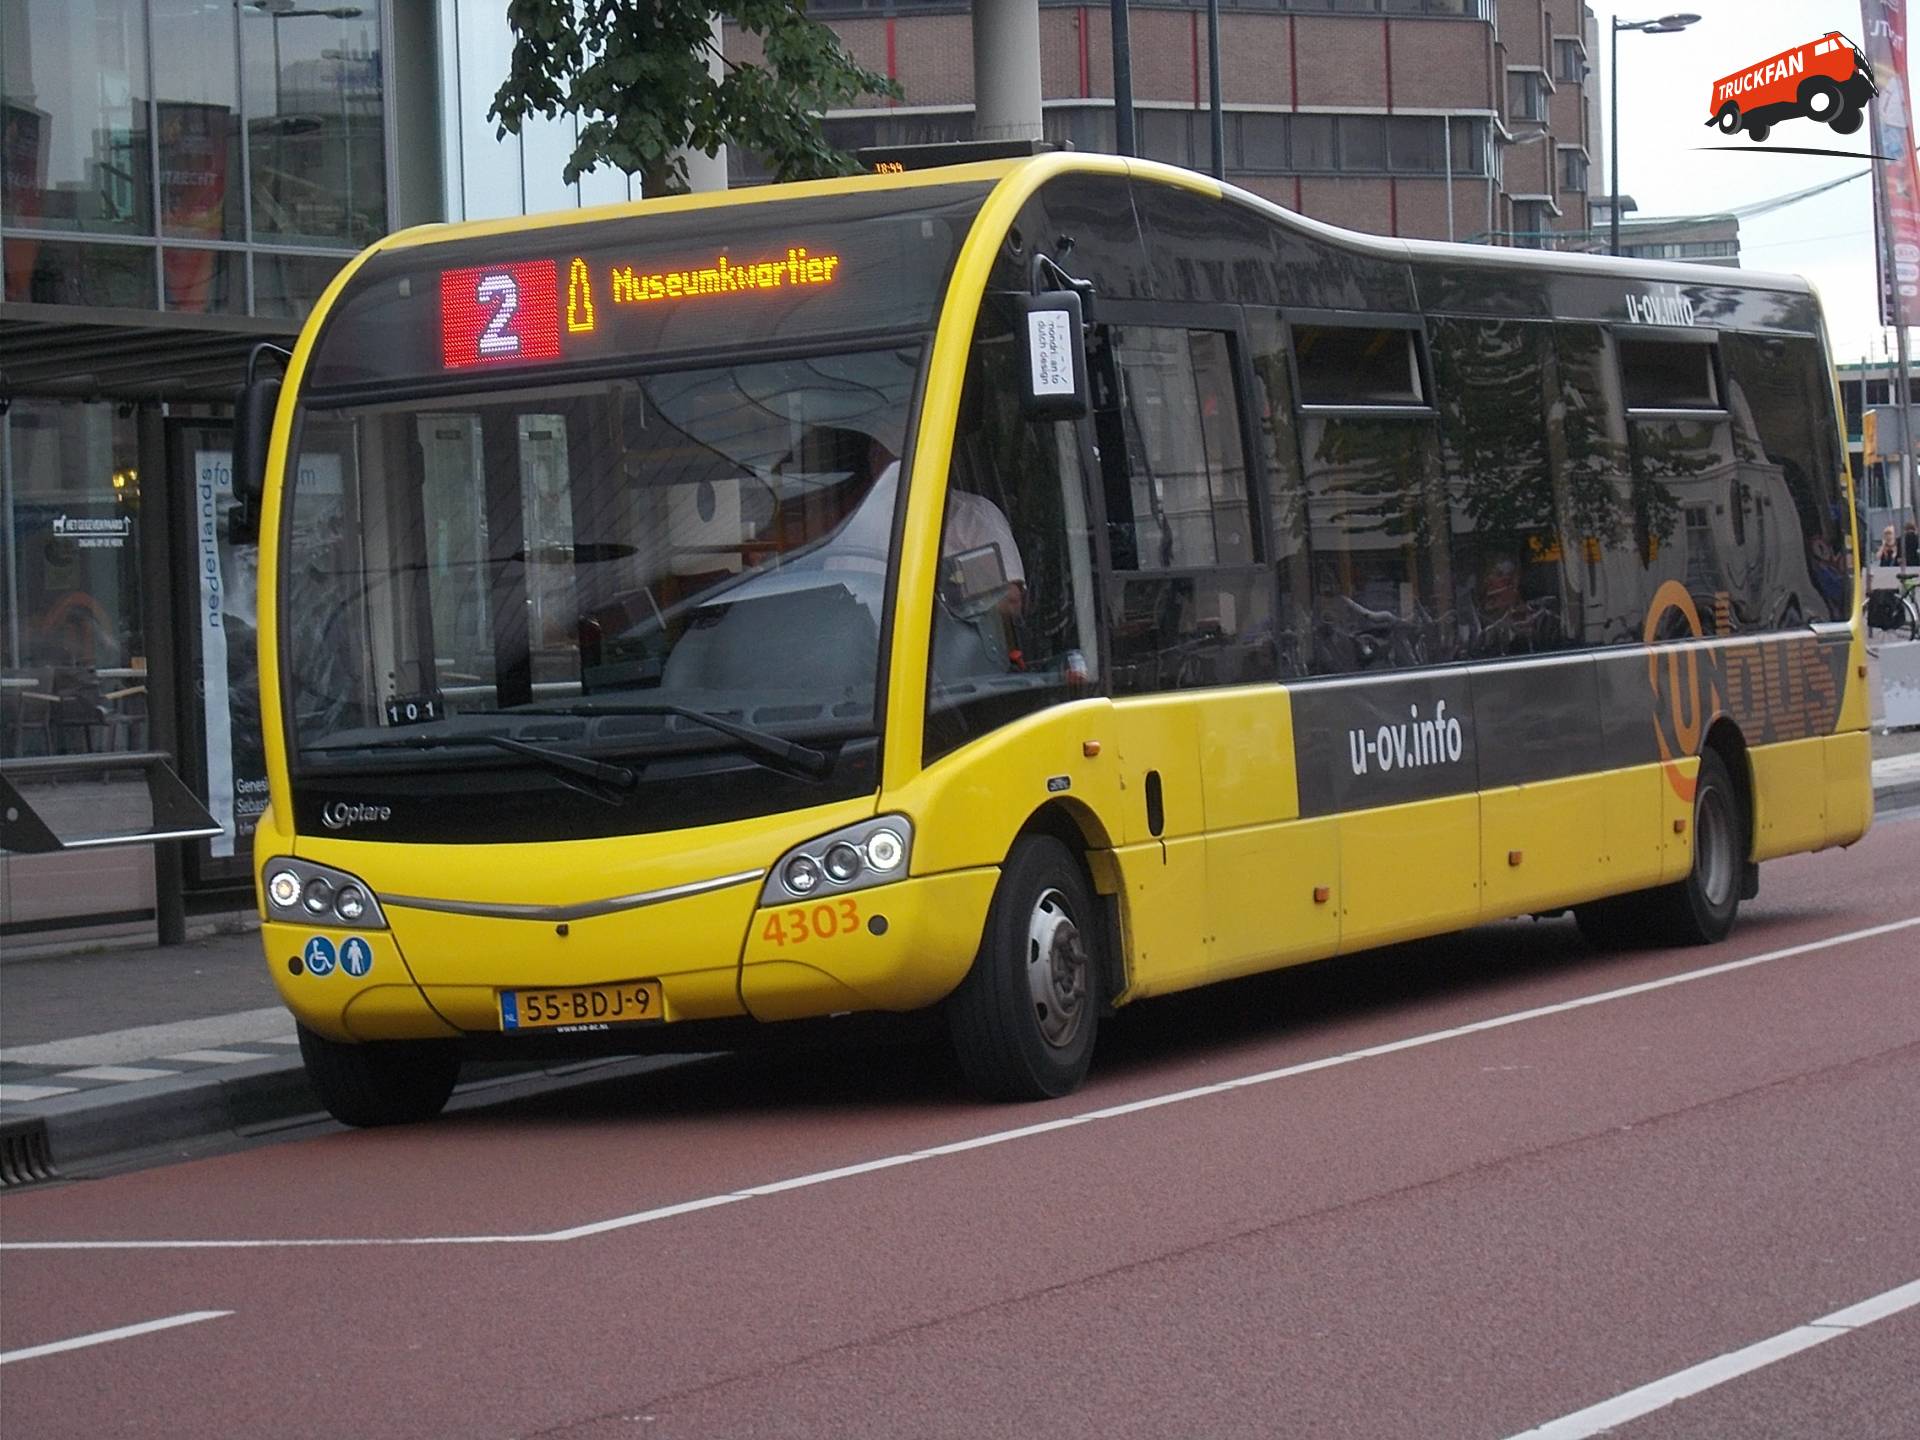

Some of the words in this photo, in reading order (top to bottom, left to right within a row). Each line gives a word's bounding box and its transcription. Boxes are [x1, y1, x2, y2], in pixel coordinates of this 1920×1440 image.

[612, 247, 839, 303] Museumkwartier
[477, 274, 520, 354] 2
[1625, 285, 1695, 327] u-ov.info
[200, 467, 220, 628] nederlands
[389, 701, 435, 722] 101
[1349, 699, 1463, 775] u-ov.info
[334, 802, 392, 827] Optare
[762, 898, 861, 947] 4303
[526, 987, 651, 1022] 55-BDJ-9
